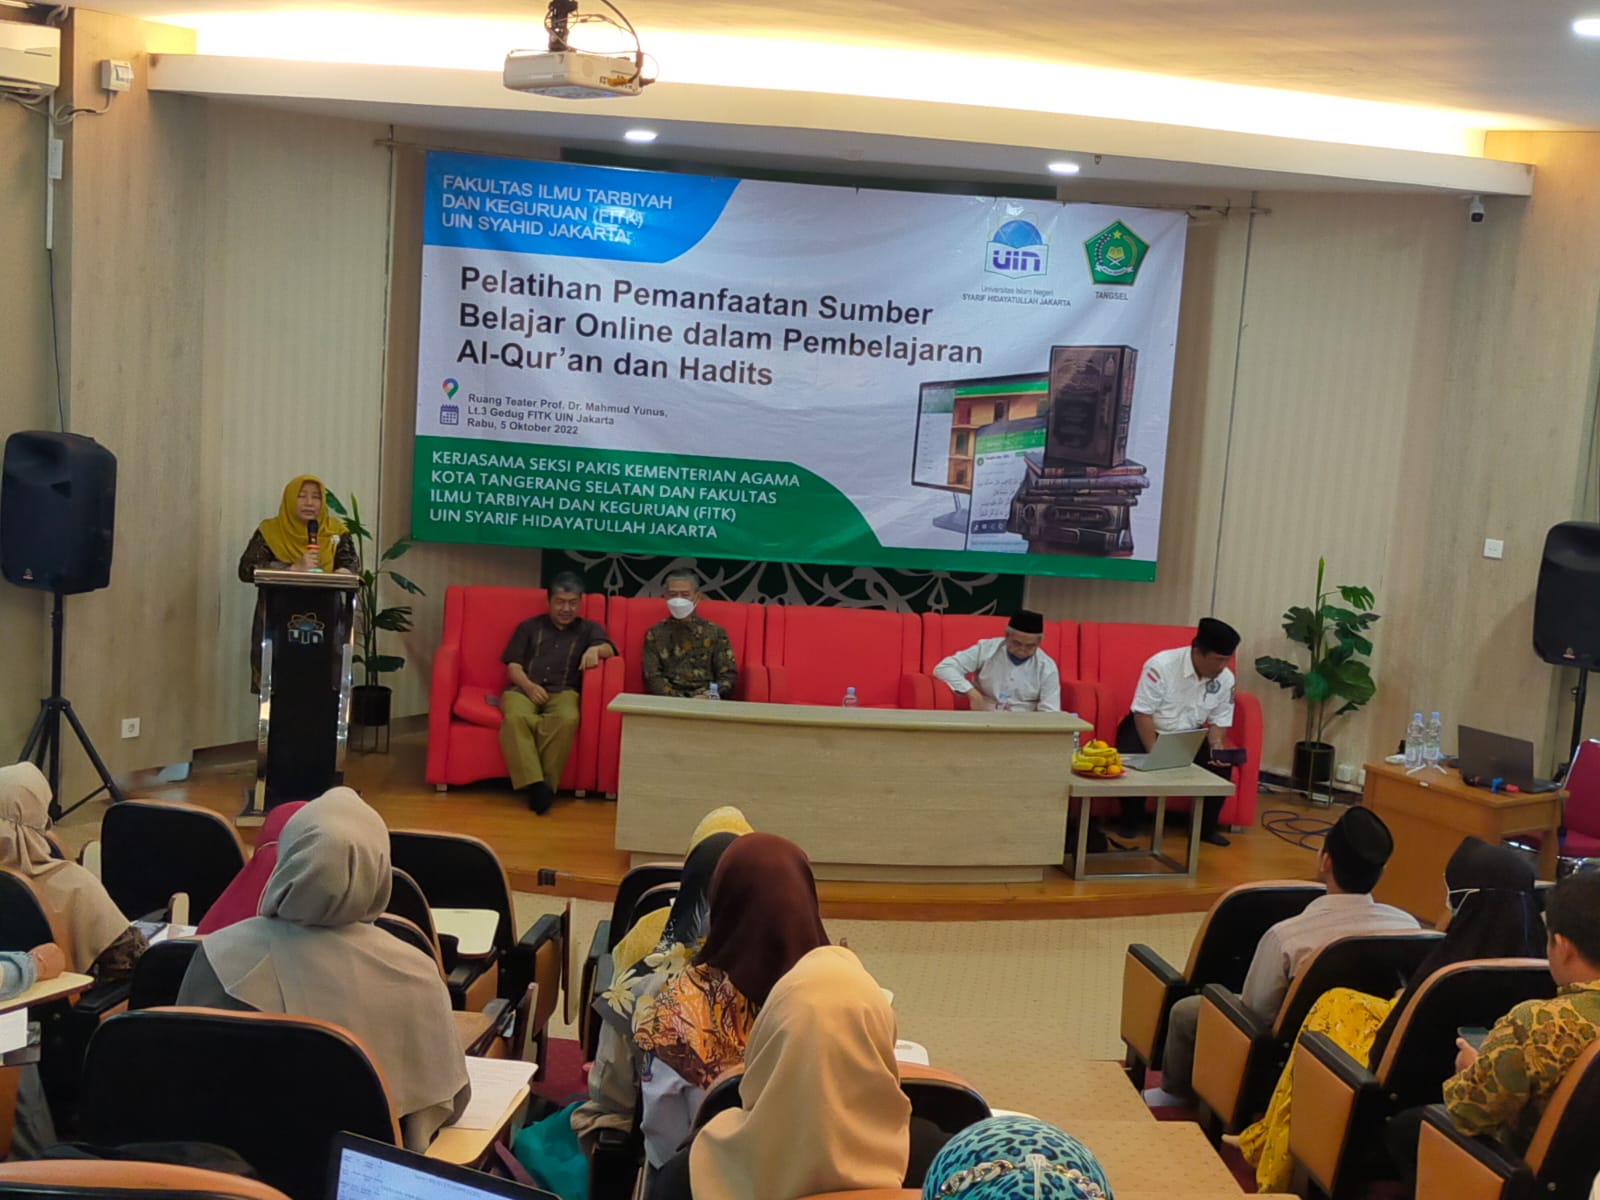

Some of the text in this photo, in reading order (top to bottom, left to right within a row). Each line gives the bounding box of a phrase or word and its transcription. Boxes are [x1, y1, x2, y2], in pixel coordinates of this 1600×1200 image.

[442, 175, 673, 209] FAKULTAS ILMU TARBIYAH
[442, 194, 644, 229] DAN KEGURUAN (FITK)
[442, 212, 627, 242] UIN SYAHID JAKARTA
[460, 266, 934, 325] Pelatihan Pemanfaatan Sumber
[962, 293, 1072, 307] SYARIF HIDAYATULLAH JAKARTA
[981, 286, 1014, 296] Universitas
[1095, 291, 1129, 301] TANGSEL
[460, 302, 983, 366] Belajar Online dalam Pembelajaran
[613, 352, 668, 379] dan
[679, 356, 773, 386] Hadits
[467, 406, 615, 425] Lt.3 Gedug FITK UIN Jakarta
[468, 393, 668, 418] Ruang Teater Prof. Dr. Mahmud Yunus,
[467, 418, 579, 435] Rabu, 5 Oktober 2022
[432, 450, 801, 487] KERJASAMA SEKSI PAKIS KEMENTERIAN AGAMA
[431, 470, 777, 504] KOTA TANGERANG SELATAN DAN FAKULTAS
[430, 489, 737, 523] ILMU TARBIYAH DAN KEGURUAN (FITK)
[429, 508, 718, 539] UIN SYARIF HIDAYATULLAH JAKARTA
